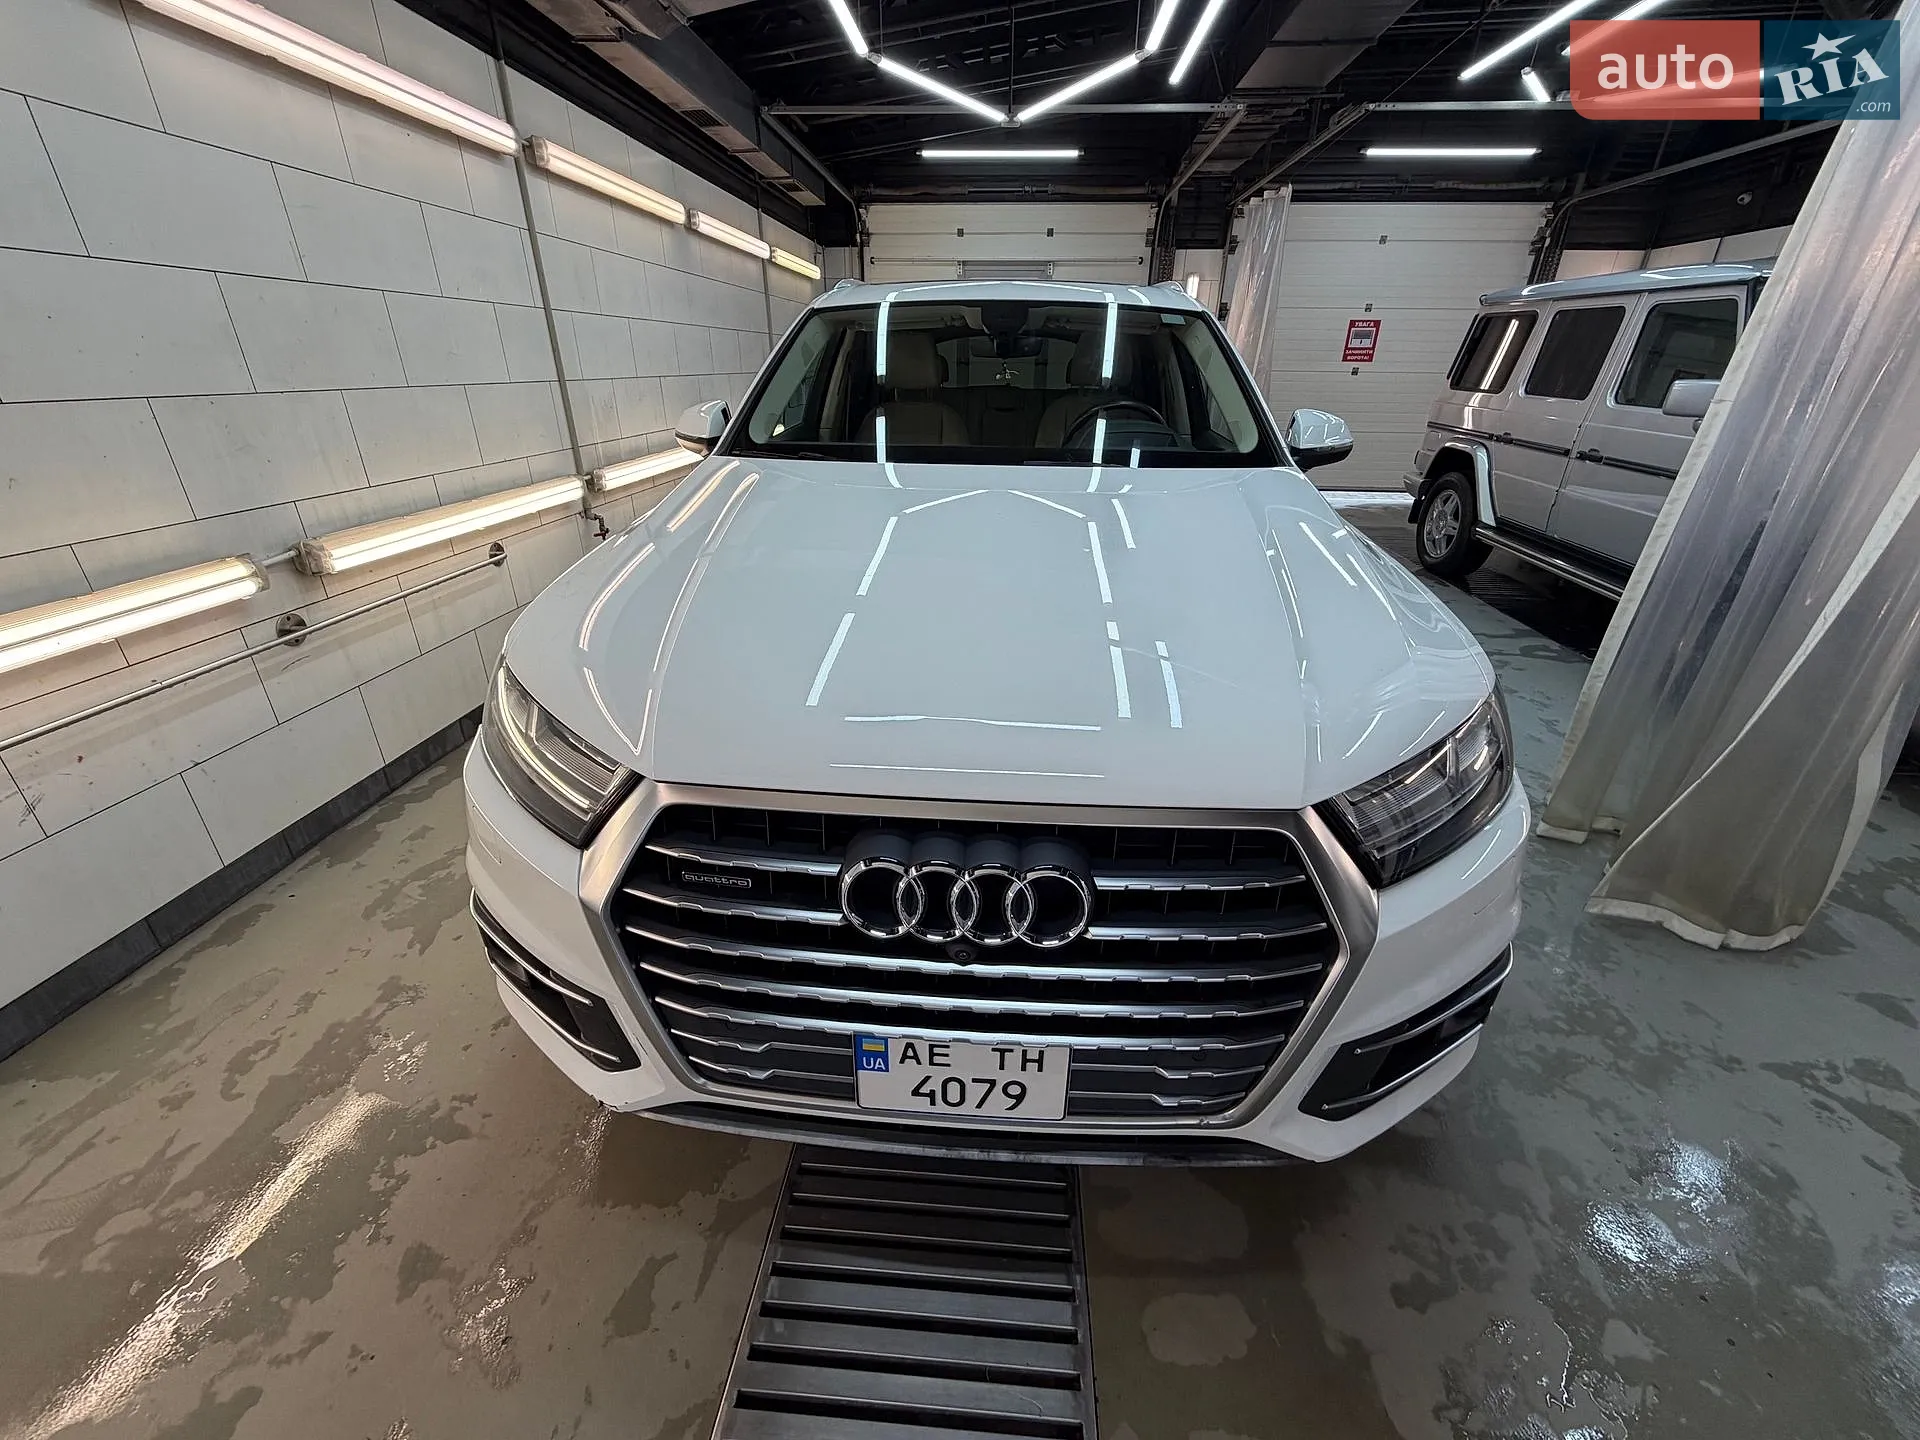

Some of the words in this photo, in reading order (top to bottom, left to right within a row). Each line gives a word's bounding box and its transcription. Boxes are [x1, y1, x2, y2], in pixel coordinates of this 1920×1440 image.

[684, 874, 748, 886] quattro
[862, 1057, 886, 1071] UA
[899, 1041, 951, 1067] AE
[991, 1048, 1045, 1073] TH
[910, 1075, 1028, 1111] 4079
